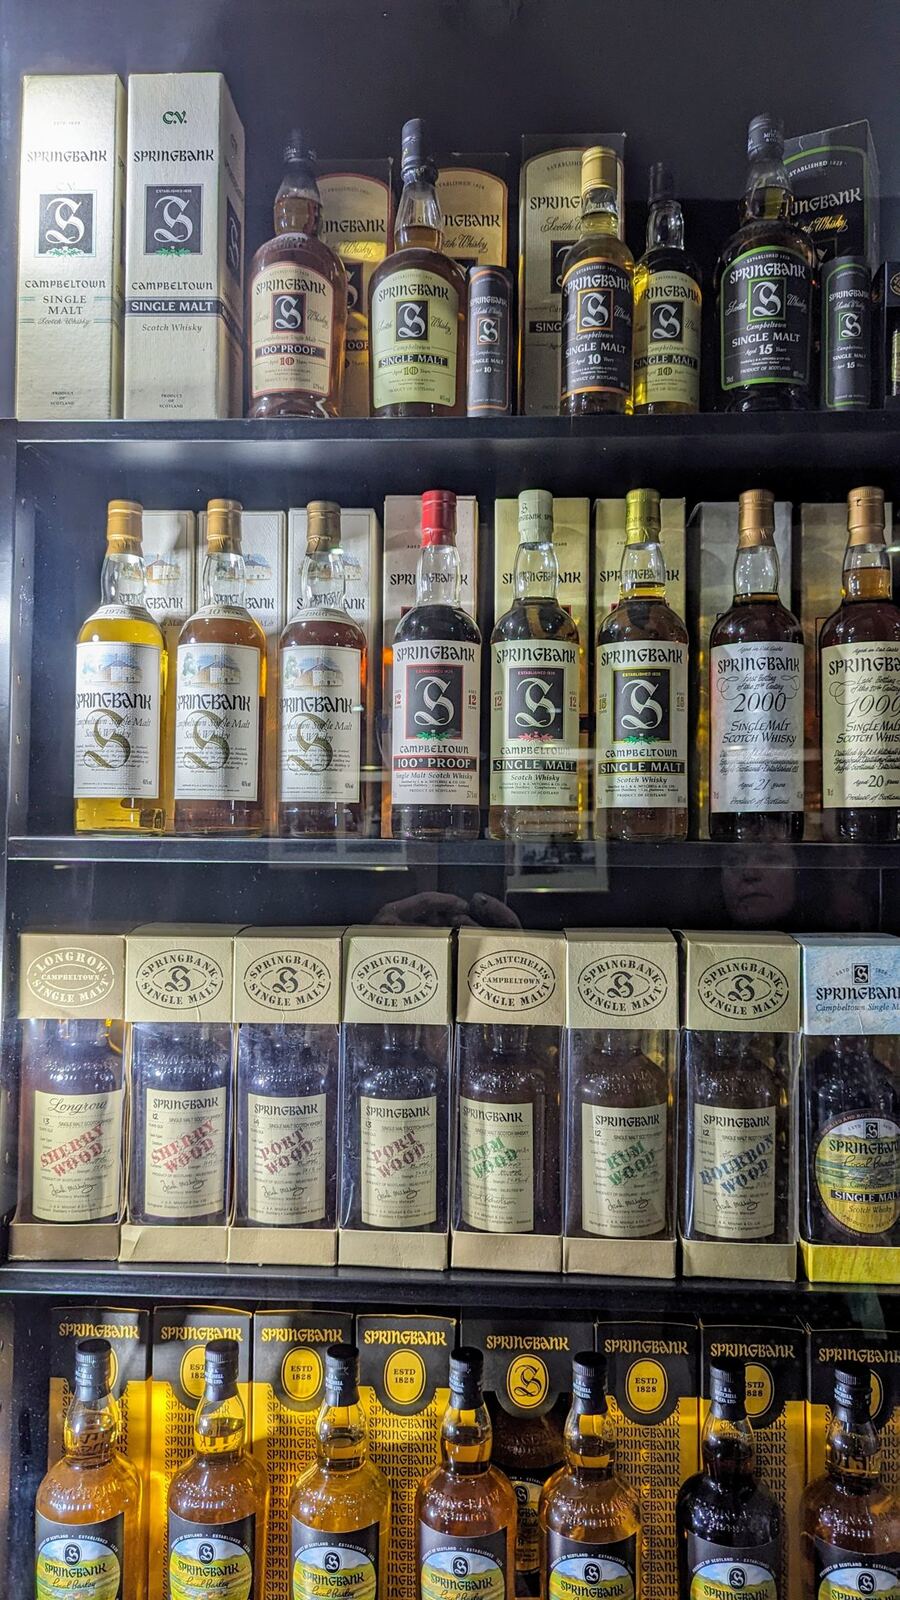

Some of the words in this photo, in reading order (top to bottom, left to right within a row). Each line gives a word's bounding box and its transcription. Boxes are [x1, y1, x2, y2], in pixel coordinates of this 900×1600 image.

[27, 150, 107, 163] SPRINGBANK
[133, 149, 215, 163] SPRINGBANK
[46, 198, 85, 245] S
[455, 235, 488, 254] Whisky
[729, 263, 806, 284] SPRINGBANK
[25, 280, 106, 290] CAMPBELTOWN
[132, 281, 213, 292] CAMPBELTOWN
[255, 278, 327, 296] SPRINGBANK
[378, 283, 449, 302] SPRINGBANK
[563, 274, 631, 297] SPRINGBANK
[43, 295, 87, 304] SINGLE
[131, 302, 176, 312] SINGLE
[179, 301, 214, 312] MALT
[752, 281, 781, 317] S
[48, 305, 83, 316] MALT
[397, 302, 426, 338] S
[430, 316, 452, 335] Whisky
[746, 321, 787, 331] Campbeltown
[142, 323, 168, 333] Scotch
[171, 323, 202, 334] Whisky
[731, 332, 769, 348] SINGLE
[773, 332, 800, 343] MALT
[281, 345, 316, 355] PROOF
[565, 342, 597, 359] SINGLE
[601, 342, 626, 354] MALT
[759, 343, 773, 355] 15
[832, 353, 852, 361] SINGLE
[280, 357, 295, 366] 10
[381, 355, 414, 367] SINGLE
[417, 354, 446, 365] MALT
[588, 354, 601, 365] 10
[635, 356, 671, 369] SINGLE
[671, 355, 696, 367] MALT
[846, 361, 856, 369] 15
[403, 366, 419, 376] 10
[484, 366, 492, 374] 10
[657, 367, 673, 376] 10
[396, 646, 475, 662] SPRINGBANK
[496, 647, 576, 664] SPRINGBANK
[601, 648, 683, 666] SPRINGBANK
[717, 656, 800, 674] SPRINGBANK
[414, 676, 455, 726] S
[468, 695, 477, 705] 12
[620, 679, 663, 730] S
[733, 692, 787, 713] 2000
[731, 720, 767, 734] SINGLE
[764, 720, 791, 732] MALT
[845, 719, 880, 734] SINGLE
[83, 708, 132, 769] S
[722, 732, 759, 744] SCOTCH
[761, 732, 796, 747] WHISKY
[836, 733, 873, 744] SCOTCH
[400, 744, 469, 754] CAMPBELTOWN
[605, 748, 678, 758] CAMPBELTOWN
[427, 758, 471, 769] PROOF
[495, 760, 541, 771] SINGLE
[545, 760, 575, 771] MALT
[600, 762, 646, 773] SINGLE
[651, 762, 681, 773] MALT
[452, 772, 473, 780] Whisky
[536, 774, 560, 782] Whisky
[616, 776, 639, 784] Scotch
[641, 776, 667, 784] Whisky
[868, 774, 884, 788] 20
[754, 778, 769, 791] 21
[36, 951, 107, 973] LONGROW
[142, 954, 218, 978] SPRINGBANK
[250, 955, 325, 979] SPRINGBANK
[357, 955, 432, 980] SPRINGBANK
[41, 973, 100, 981] CAMPBELTOWN
[164, 965, 191, 992] S
[583, 960, 662, 984] SPRINGBANK
[704, 962, 784, 988] SPRINGBANK
[482, 977, 540, 985] CAMPBELTOWN
[32, 979, 75, 1003] SINGLE
[79, 978, 110, 1002] MALT
[141, 981, 183, 1005] SINGLE
[188, 981, 218, 1004] MALT
[249, 983, 291, 1007] SINGLE
[296, 983, 325, 1006] MALT
[356, 984, 398, 1008] SINGLE
[403, 984, 432, 1007] MALT
[472, 982, 515, 1007] SINGLE
[520, 982, 550, 1006] MALT
[583, 987, 627, 1012] SINGLE
[632, 986, 663, 1010] MALT
[703, 991, 748, 1015] SINGLE
[752, 991, 784, 1015] MALT
[816, 1003, 865, 1012] Campbeltown
[867, 1003, 890, 1012] Single
[49, 1098, 108, 1115] Longrow
[153, 1097, 219, 1110] SPRINGBANK
[254, 1103, 318, 1116] SPRINGBANK
[365, 1106, 430, 1119] SPRINGBANK
[463, 1106, 523, 1122] SPRINGBANK
[595, 1114, 660, 1127] SPRINGBANK
[703, 1114, 770, 1128] SPRINGBANK
[702, 1129, 709, 1137] 12
[40, 1123, 103, 1168] SHERRY
[151, 1120, 213, 1164] SHERRY
[260, 1128, 304, 1161] PORT
[371, 1129, 416, 1164] PORT
[52, 1143, 103, 1177] WOOD
[164, 1138, 213, 1173] WOOD
[264, 1140, 314, 1175] WOOD
[377, 1143, 426, 1178] WOOD
[606, 1141, 646, 1169] RUM
[699, 1136, 773, 1185] BOURBON
[608, 1149, 656, 1186] WOOD
[721, 1159, 768, 1194] WOOD
[834, 1191, 876, 1202] SINGLE
[848, 1205, 872, 1213] Scotch
[59, 1322, 140, 1339] SPRINGBANK
[160, 1326, 244, 1341] SPRINGBANK
[261, 1327, 344, 1343] SPRINGBANK
[364, 1330, 447, 1346] SPRINGBANK
[486, 1335, 570, 1351] SPRINGBANK
[604, 1339, 689, 1355] SPRINGBANK
[710, 1343, 796, 1358] SPRINGBANK
[292, 1373, 312, 1381] 1828
[513, 1364, 542, 1397] S
[369, 1417, 438, 1429] SPRINGBANK
[369, 1429, 438, 1441] SPRINGBANK
[369, 1441, 438, 1453] SPRINGBANK
[369, 1454, 438, 1465] SPRINGBANK
[44, 1562, 108, 1578] SPRINGBANK
[177, 1561, 240, 1577] SPRINGBANK
[302, 1569, 364, 1586] SPRINGBANK
[430, 1573, 494, 1590] SPRINGBANK
[560, 1579, 625, 1597] SPRINGBANK
